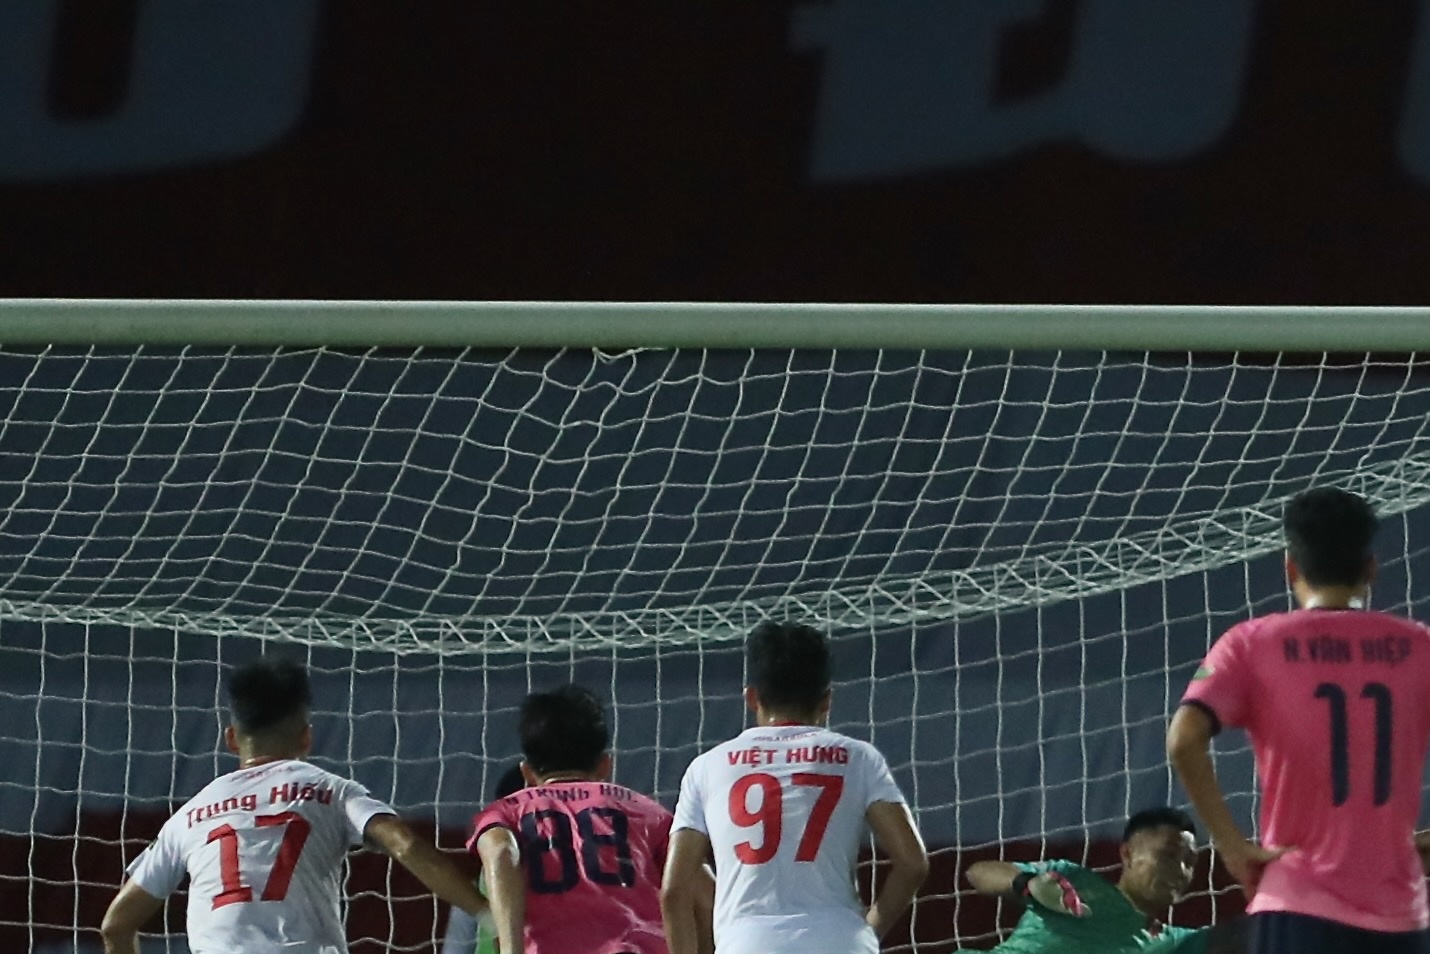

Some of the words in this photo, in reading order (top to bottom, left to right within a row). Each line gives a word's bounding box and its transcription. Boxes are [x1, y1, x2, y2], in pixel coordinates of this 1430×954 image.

[727, 746, 778, 768] VIỆT
[1314, 681, 1393, 808] 11
[186, 794, 257, 829] Trung
[519, 807, 637, 893] 88
[728, 772, 844, 865] 97
[206, 811, 311, 911] 17
